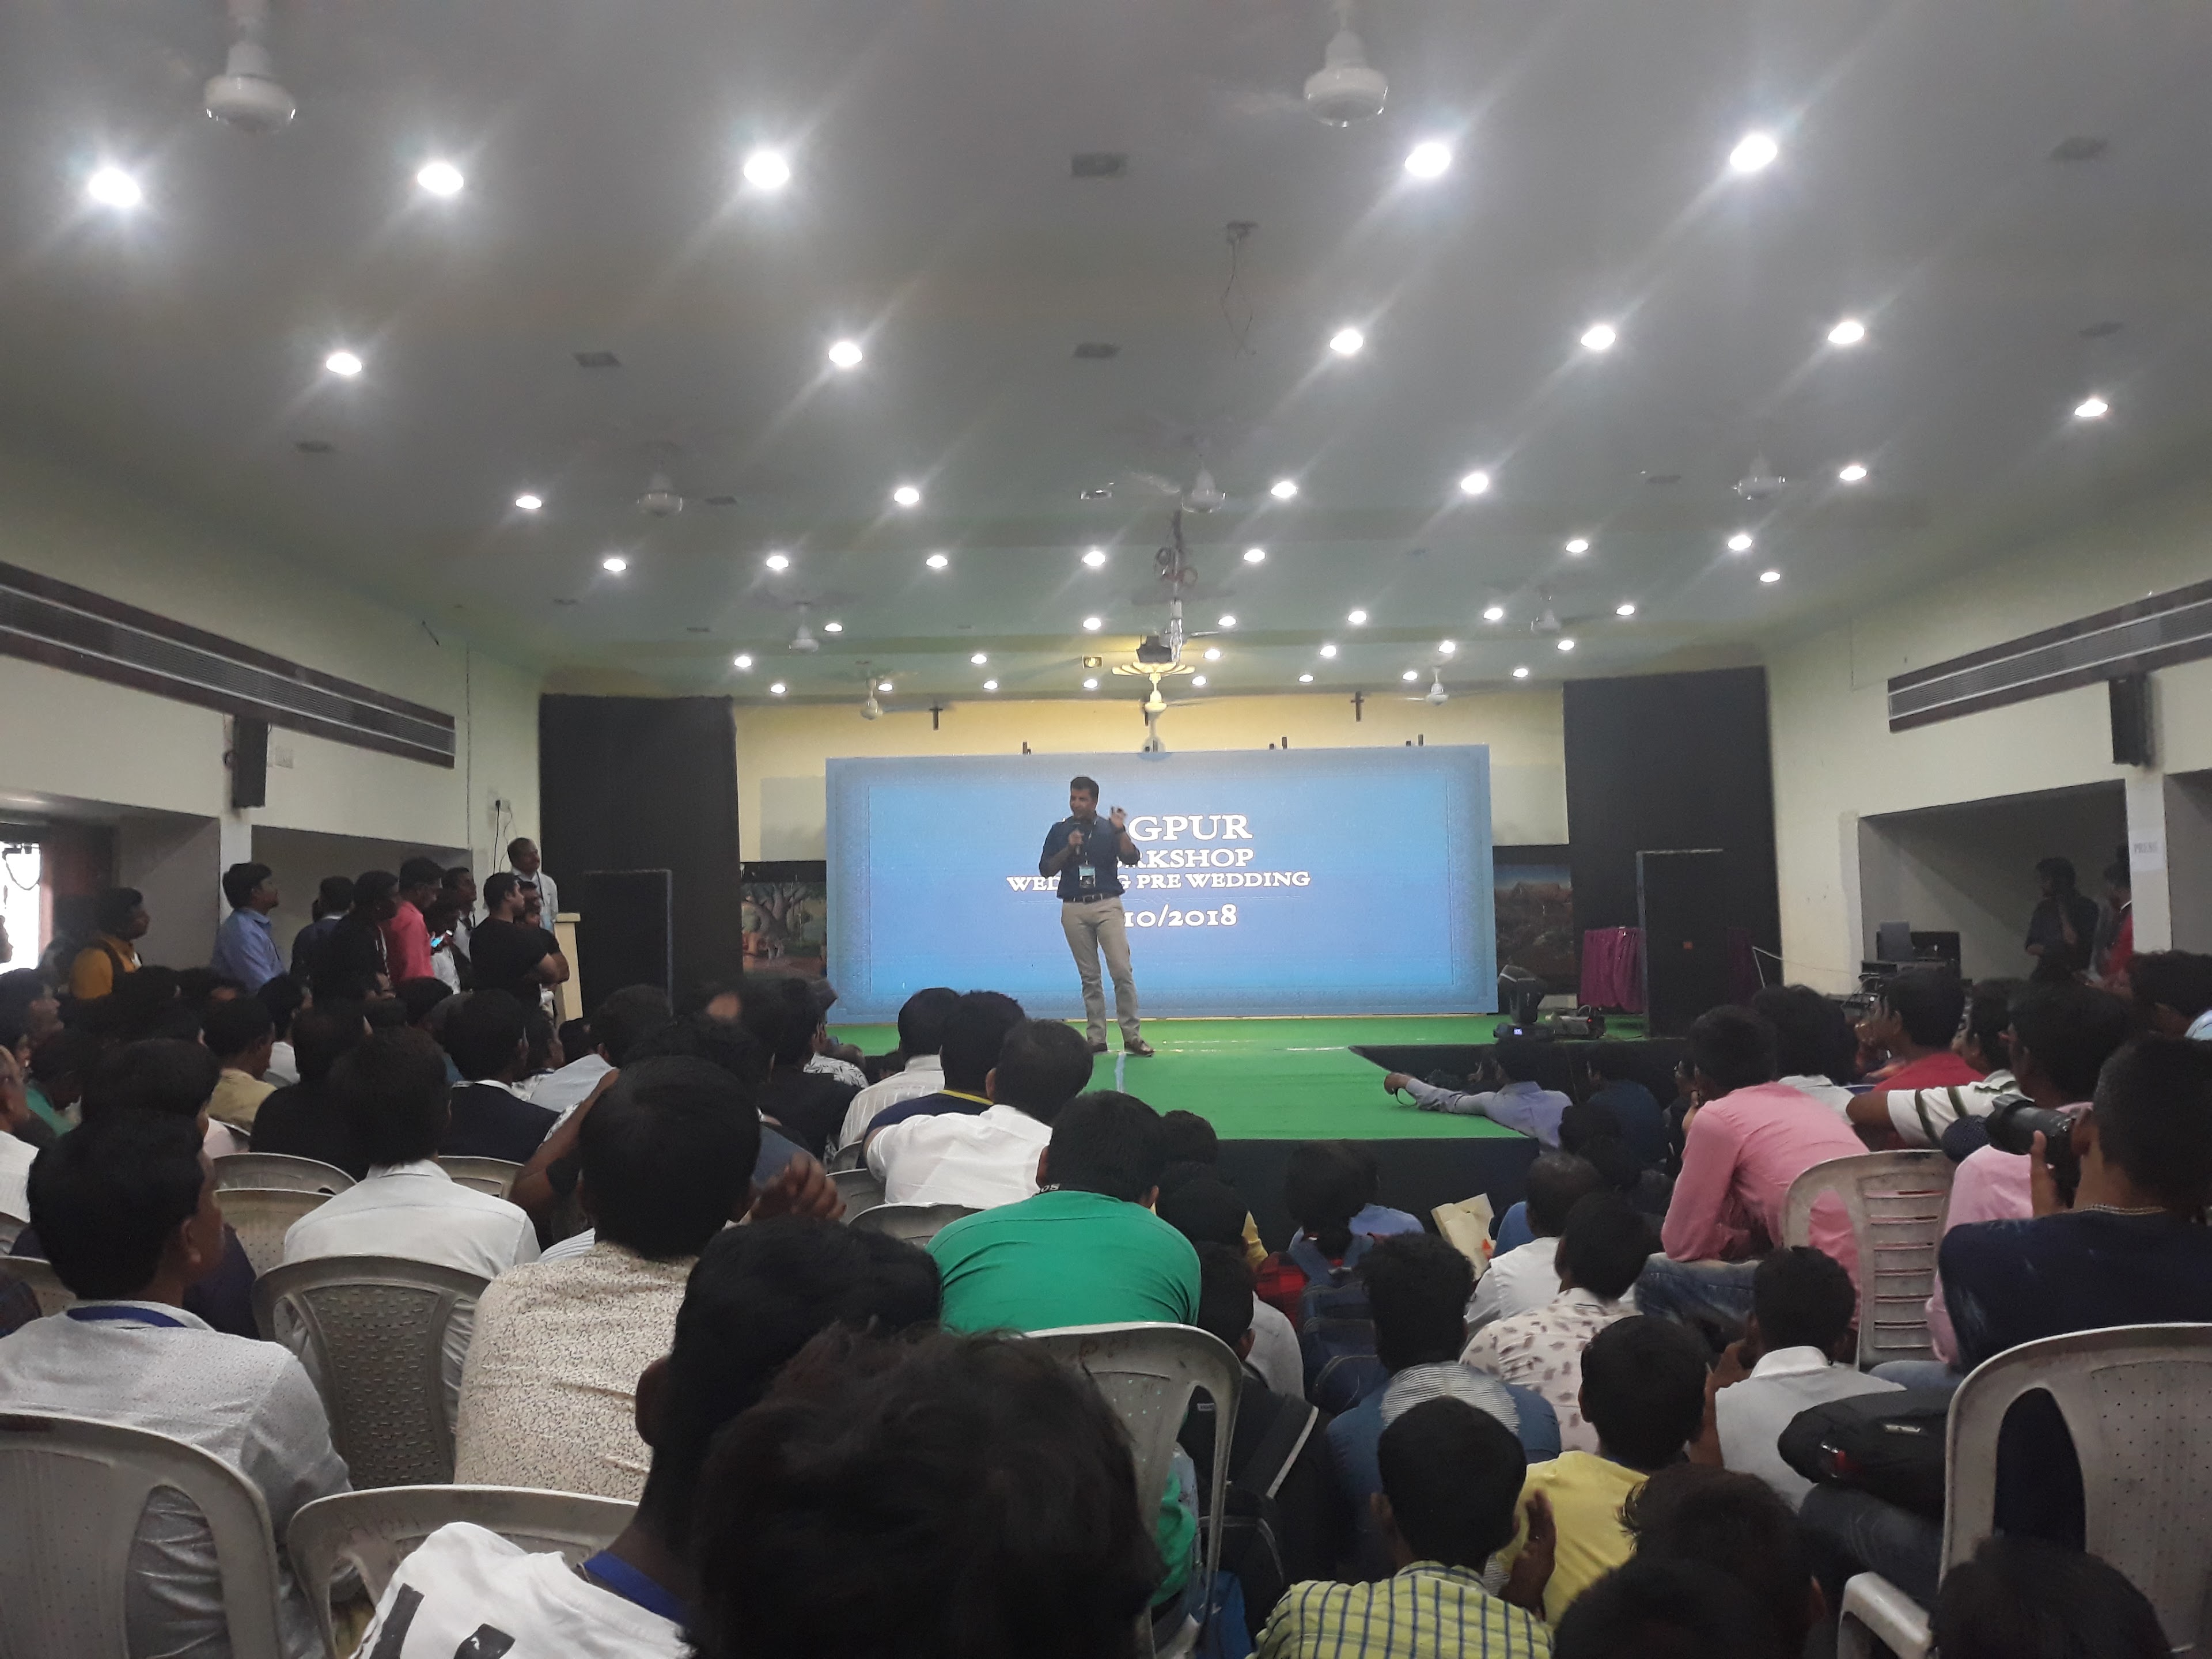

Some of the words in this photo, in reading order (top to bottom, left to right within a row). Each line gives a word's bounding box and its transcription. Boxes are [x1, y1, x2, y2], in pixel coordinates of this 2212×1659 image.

[1128, 814, 1253, 842] GPUR
[1117, 848, 1254, 869] KSHOP
[1006, 874, 1131, 891] WEDG
[1137, 873, 1181, 889] PRE
[1185, 871, 1310, 888] WEDDING
[1124, 904, 1237, 927] 10/2018
